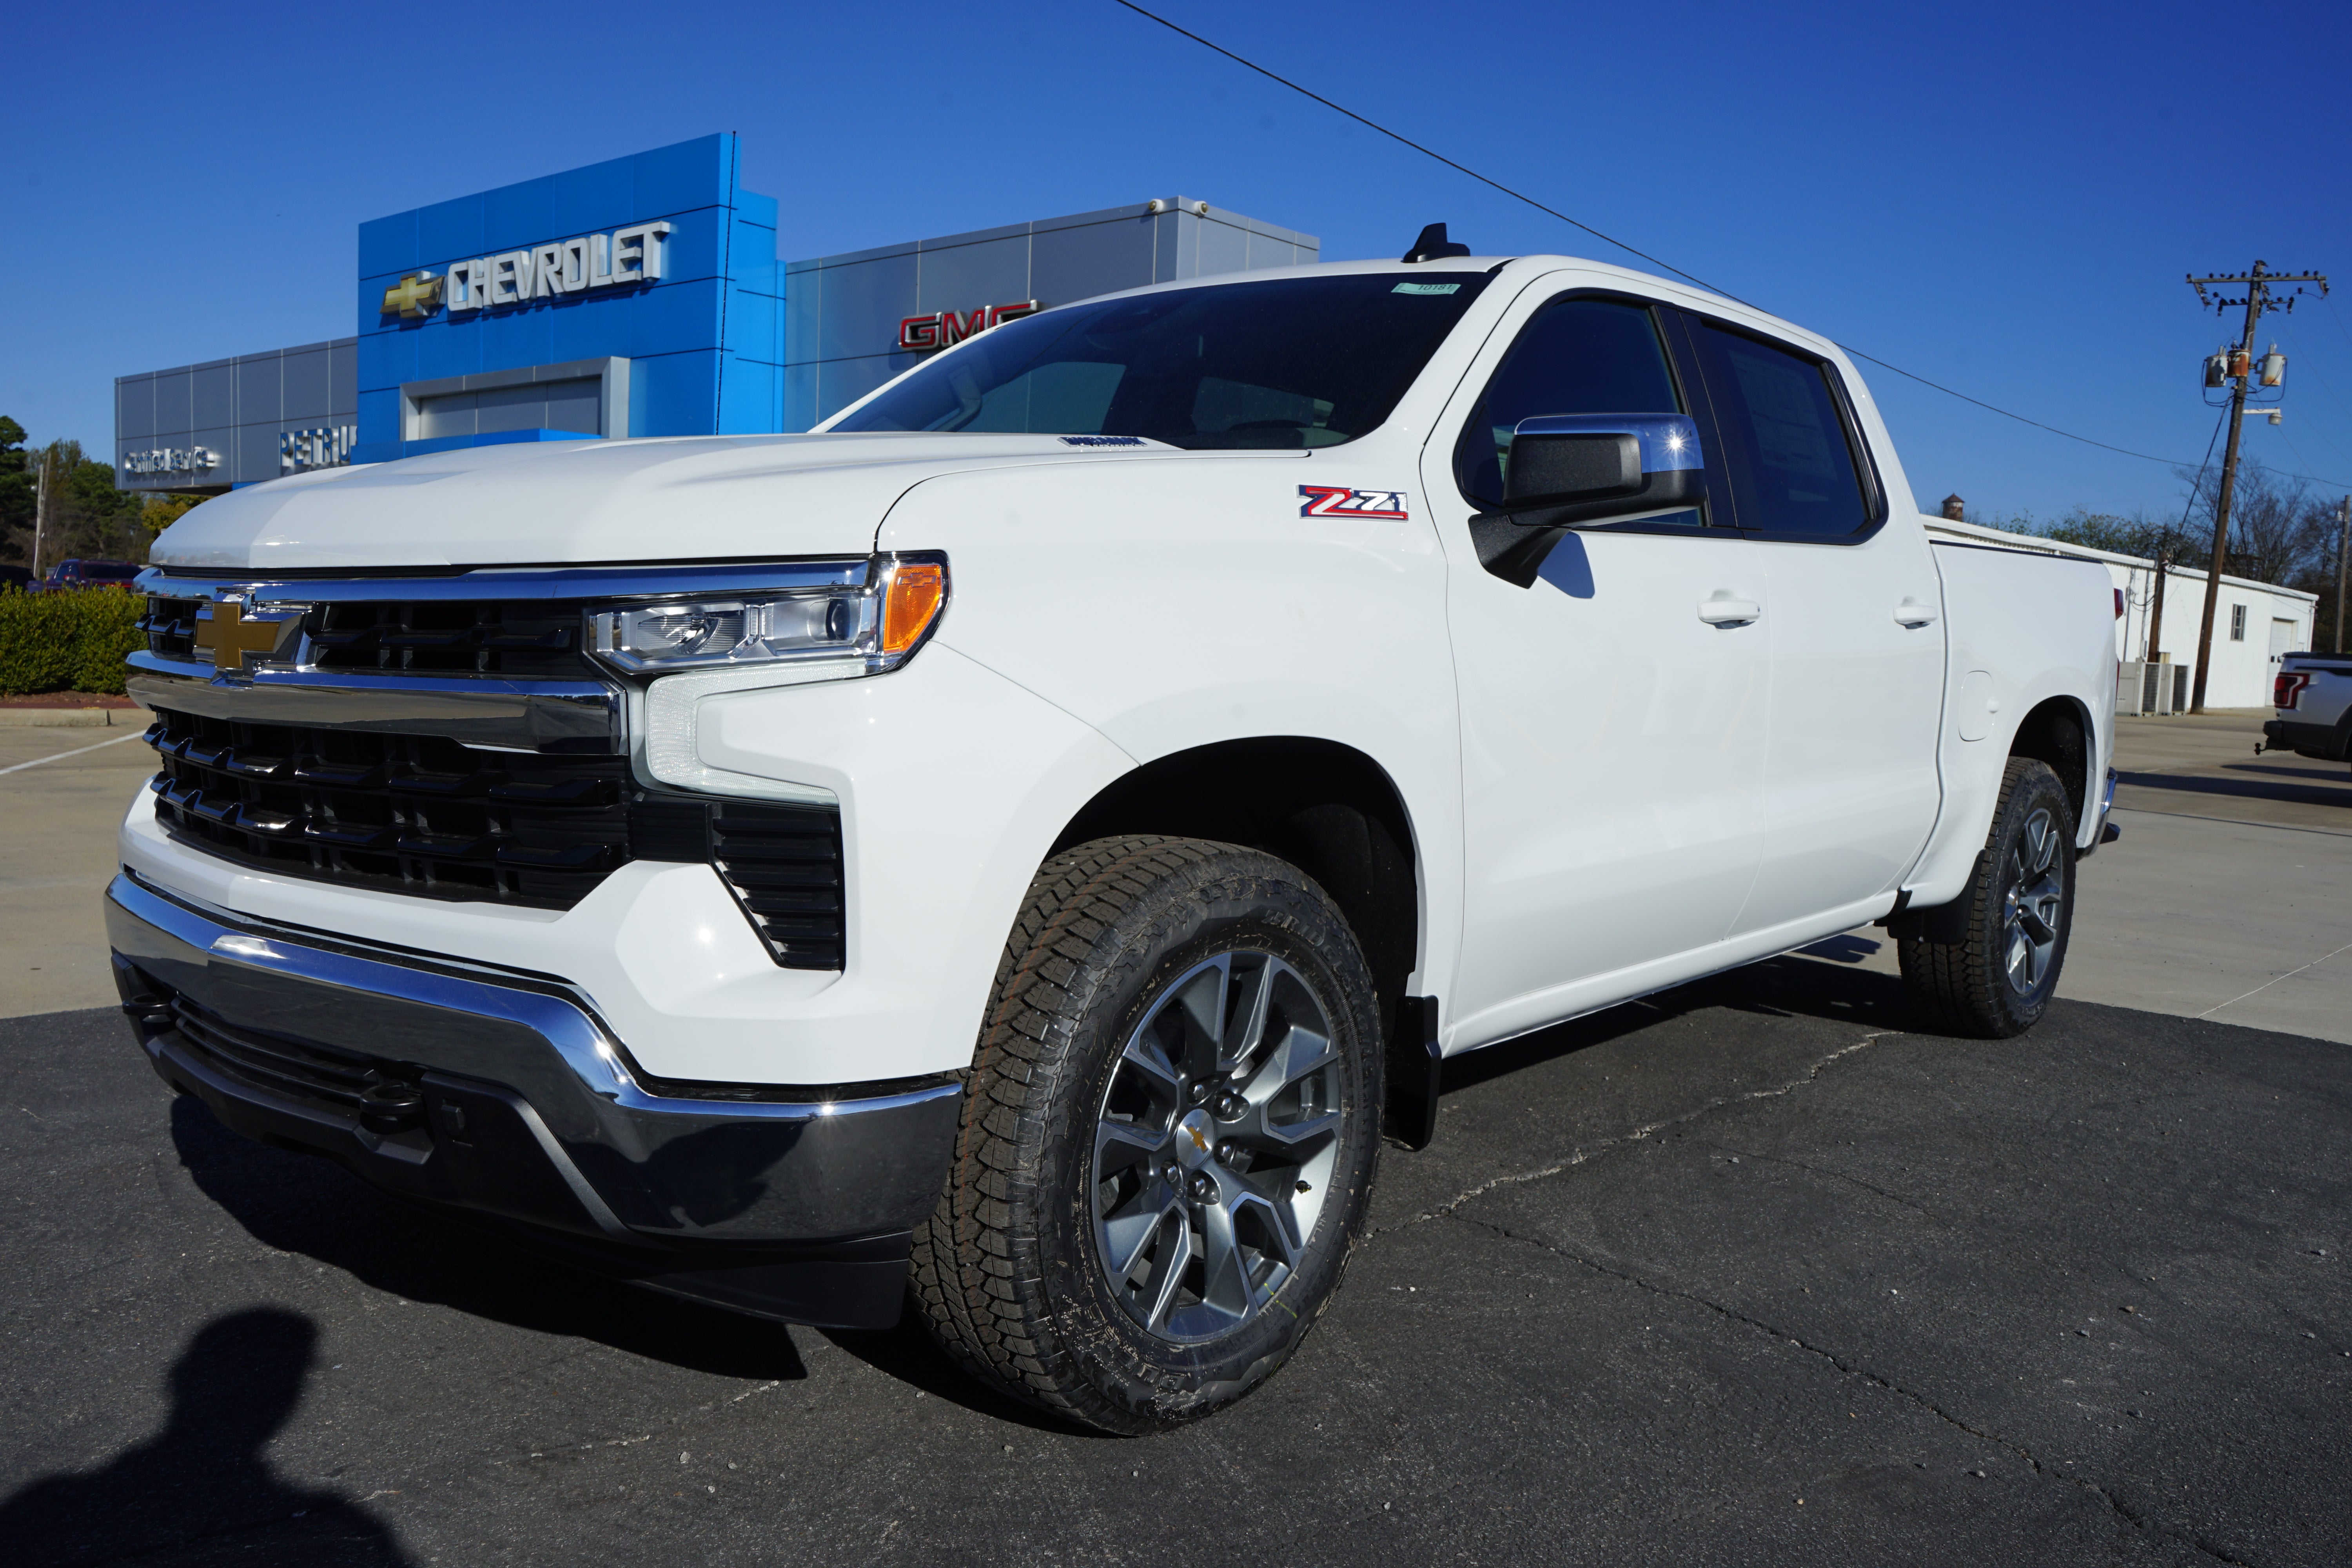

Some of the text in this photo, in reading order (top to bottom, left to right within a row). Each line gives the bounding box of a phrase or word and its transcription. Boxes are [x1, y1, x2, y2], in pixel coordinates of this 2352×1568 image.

[447, 220, 670, 312] CHEVROLET
[123, 446, 214, 473] Certified Service
[279, 424, 358, 465] PETRU
[1296, 485, 1408, 523] Z71
